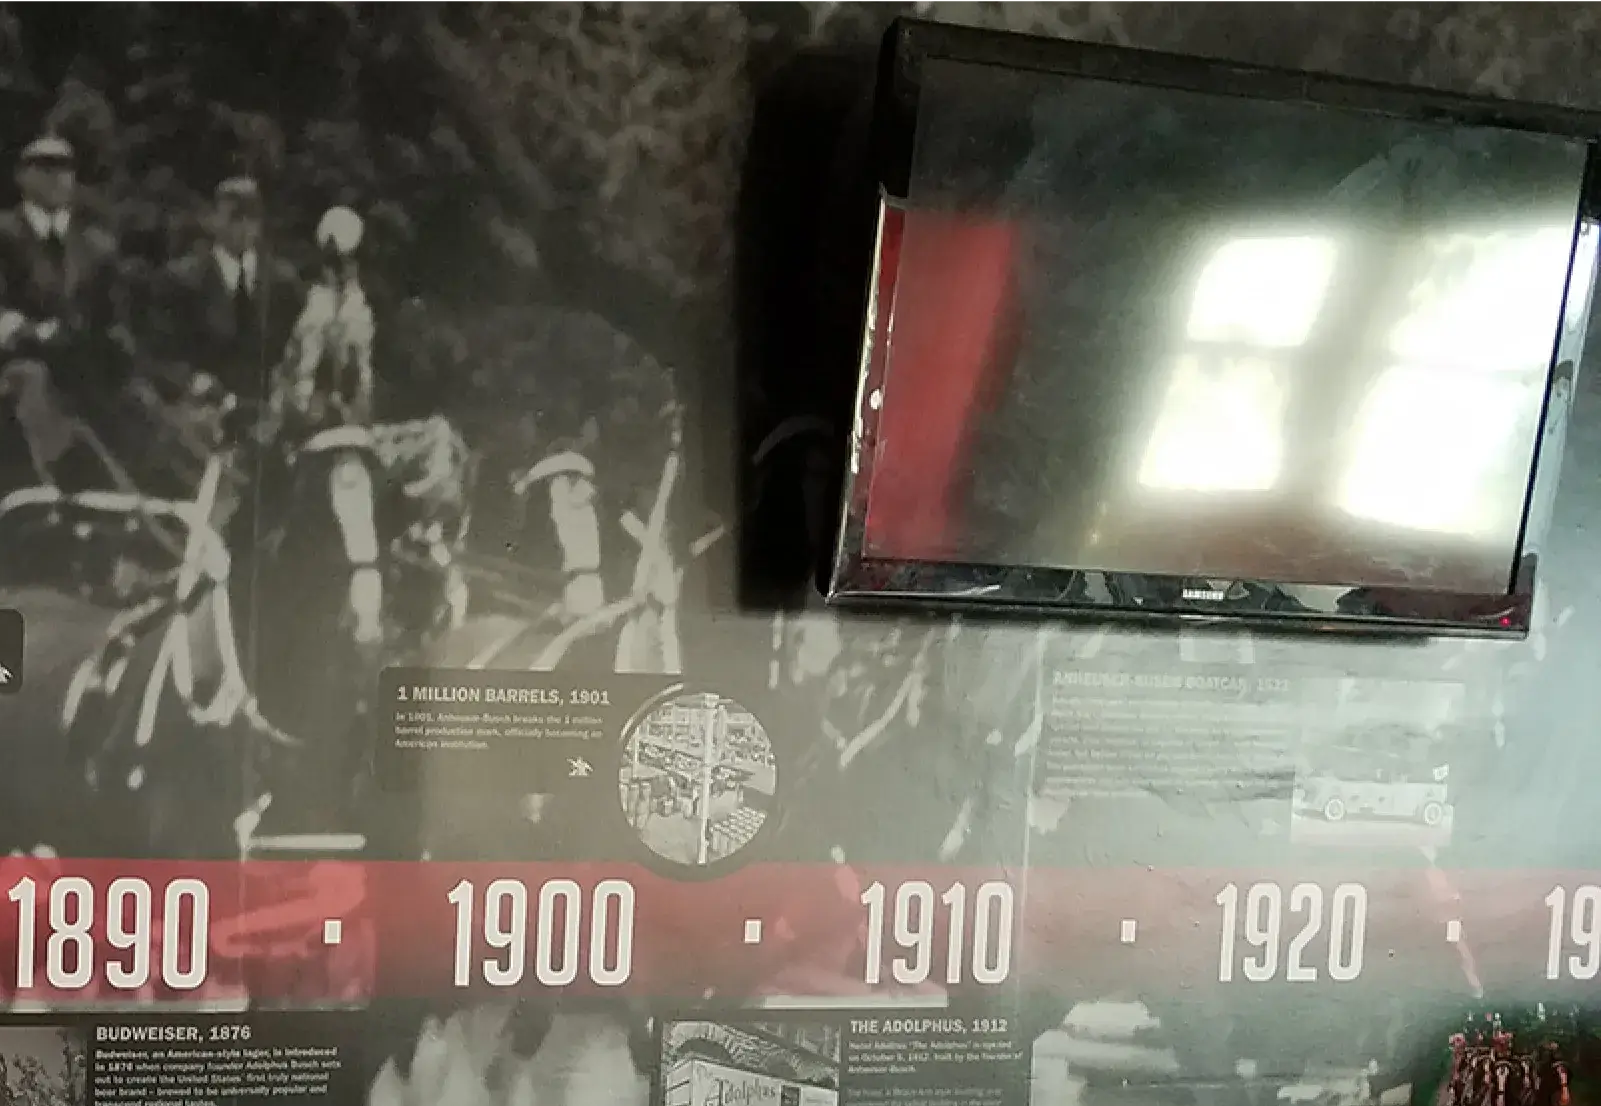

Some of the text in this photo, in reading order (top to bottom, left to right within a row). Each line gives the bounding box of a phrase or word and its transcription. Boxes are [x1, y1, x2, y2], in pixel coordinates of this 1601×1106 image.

[397, 686, 610, 707] 1 MILLION BARRELS, 1901
[7, 875, 210, 990] 1890
[447, 876, 633, 989] 1900
[860, 880, 1013, 985] 1910
[1215, 880, 1368, 984] 1920
[95, 1024, 252, 1044] BUDWEISER, 1876
[850, 1018, 1008, 1034] THE ADOLPHUS, 1912
[96, 1049, 150, 1060] Budweiser,
[284, 1046, 338, 1056] introduced
[162, 1062, 205, 1073] company
[206, 1060, 244, 1071] founder
[244, 1060, 288, 1071] Adolphus
[126, 1074, 158, 1084] create
[158, 1074, 176, 1084] the
